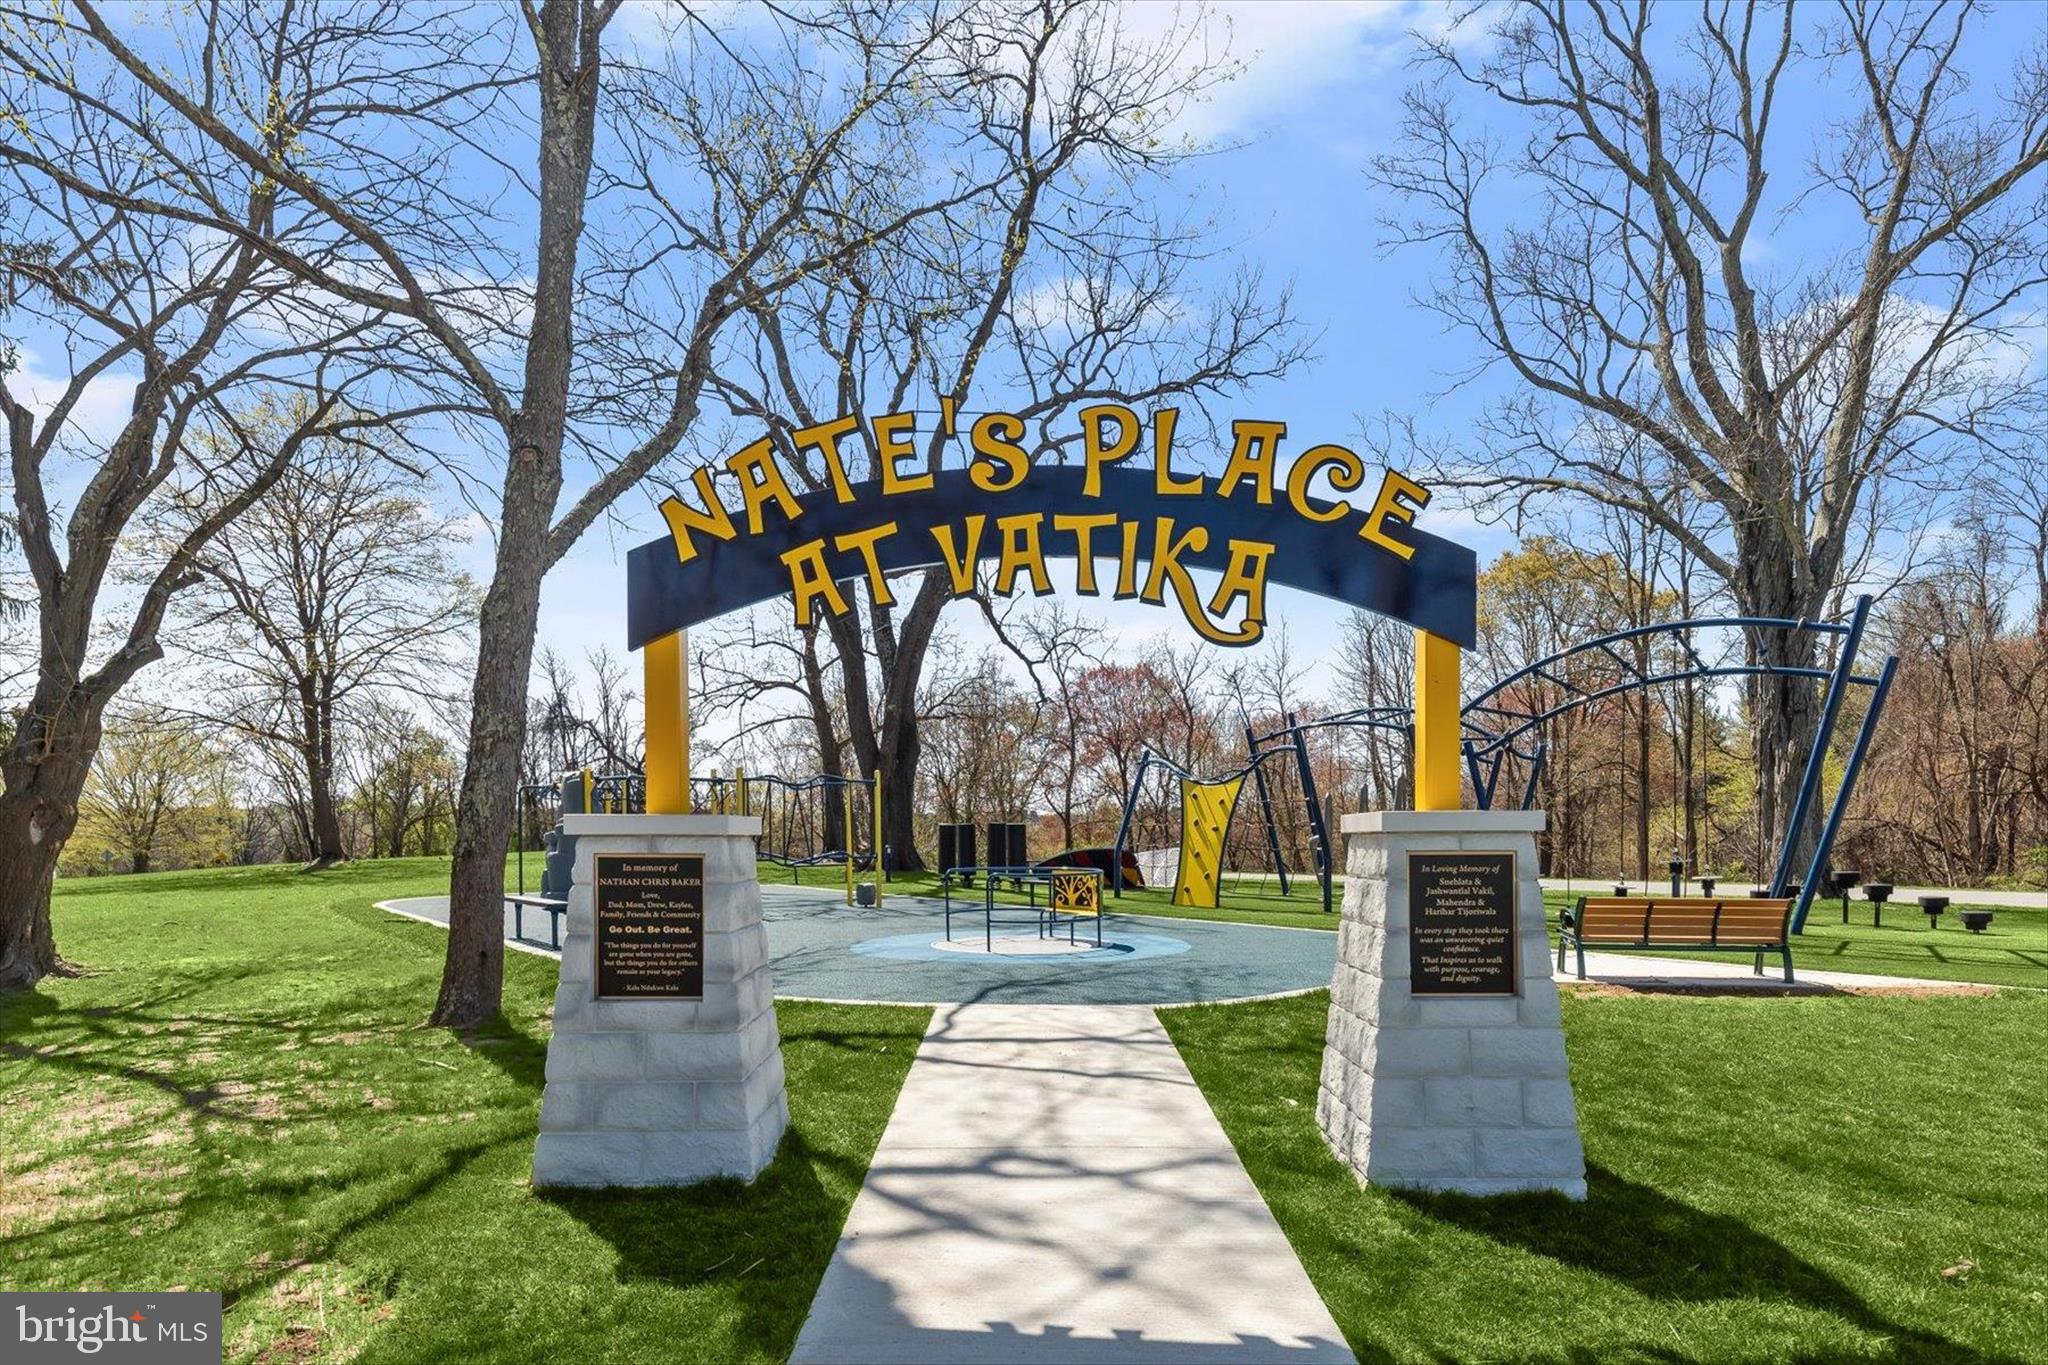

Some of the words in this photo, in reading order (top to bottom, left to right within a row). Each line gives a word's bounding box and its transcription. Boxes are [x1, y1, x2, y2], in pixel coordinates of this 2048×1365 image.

[658, 396, 1032, 566] NATE'S
[1080, 404, 1433, 562] PLACE
[779, 520, 900, 631] AT
[930, 510, 1282, 648] VATIKA
[622, 863, 632, 872] In
[633, 865, 667, 873] memory
[669, 863, 679, 872] of
[1432, 865, 1458, 874] Loving
[1459, 865, 1490, 874] Memory
[1492, 865, 1501, 874] of
[599, 878, 641, 886] NATHAN
[641, 878, 670, 886] CHRIS
[671, 878, 701, 886] BAKER
[1474, 878, 1482, 886] &
[641, 891, 660, 899] Love,
[1436, 898, 1476, 906] Mahendra
[1477, 898, 1485, 906] &
[600, 911, 626, 920] Family,
[626, 911, 652, 919] Friends
[652, 911, 660, 919] &
[660, 911, 701, 920] Community
[608, 925, 623, 934] Go
[625, 925, 645, 934] Out.
[647, 925, 661, 934] Be
[663, 925, 693, 934] Great.
[1424, 928, 1442, 936] every
[1443, 927, 1457, 936] step
[1458, 927, 1473, 936] they
[1486, 936, 1505, 945] quiet
[627, 959, 646, 967] things
